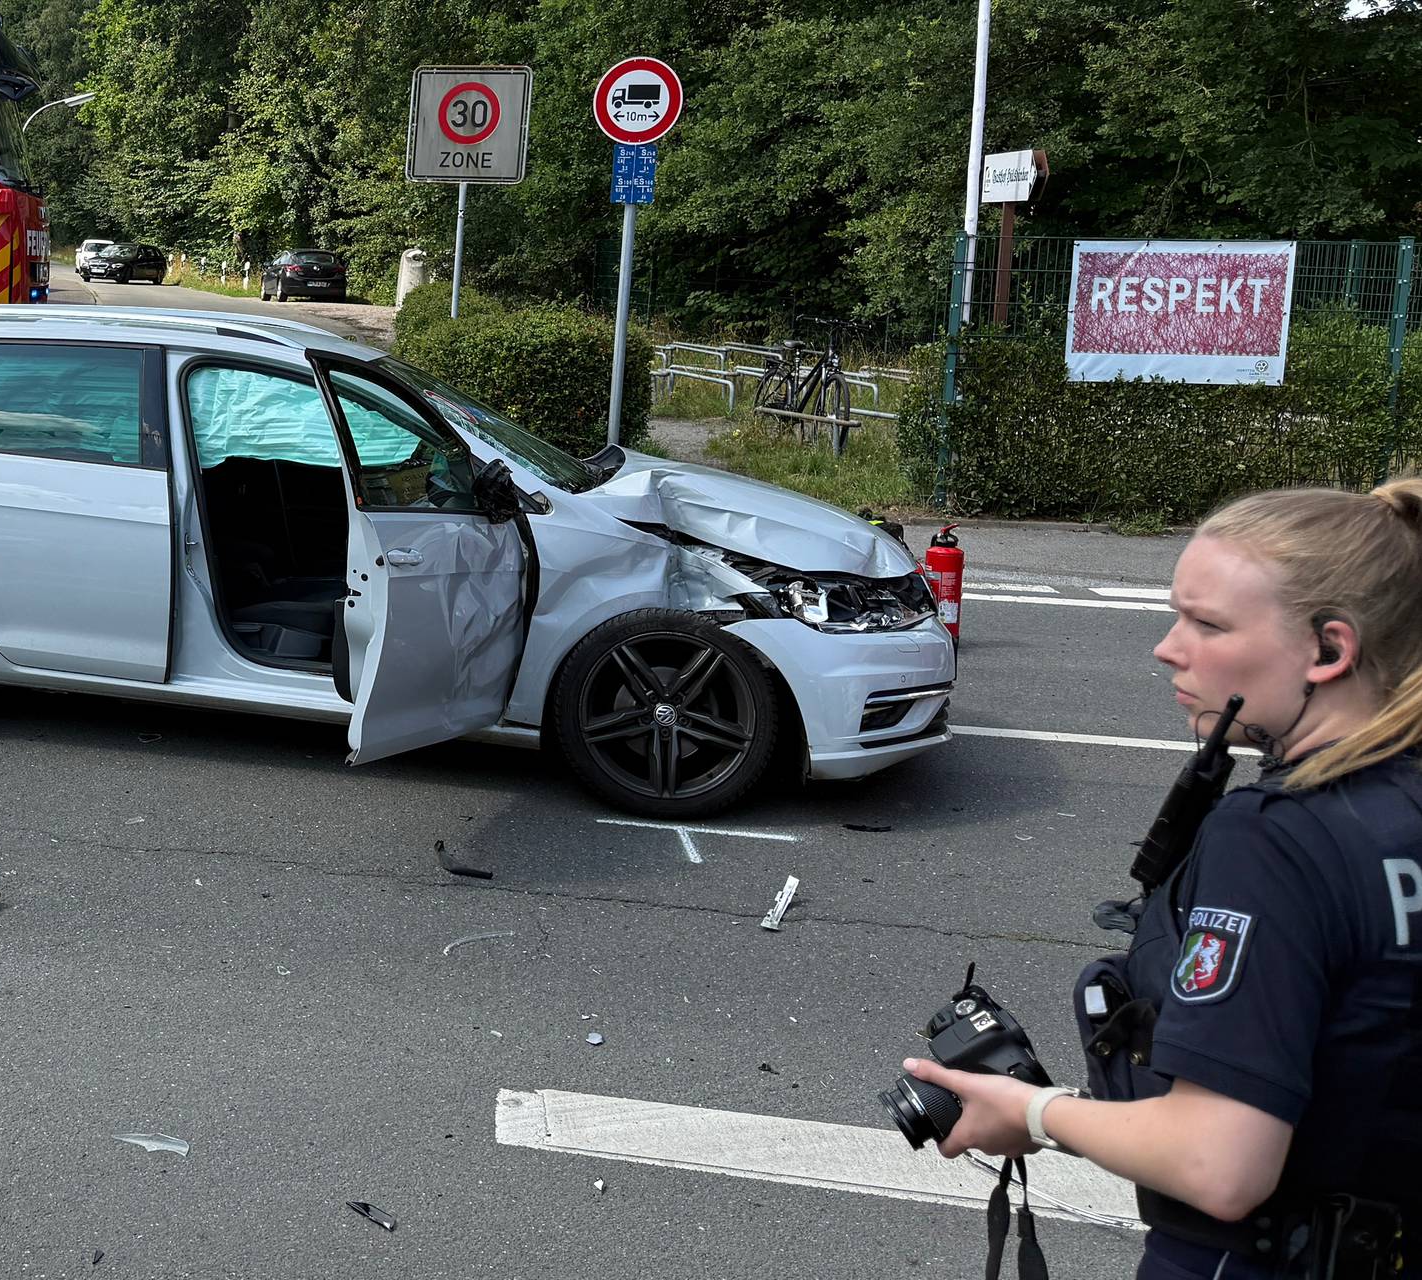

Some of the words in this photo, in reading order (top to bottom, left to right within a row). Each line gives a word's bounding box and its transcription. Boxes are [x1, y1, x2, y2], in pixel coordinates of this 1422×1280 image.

[451, 100, 488, 127] 30
[626, 112, 647, 121] 10m
[439, 152, 492, 168] ZONE
[1091, 276, 1270, 316] RESPEKT
[1189, 912, 1246, 934] POLIZEI
